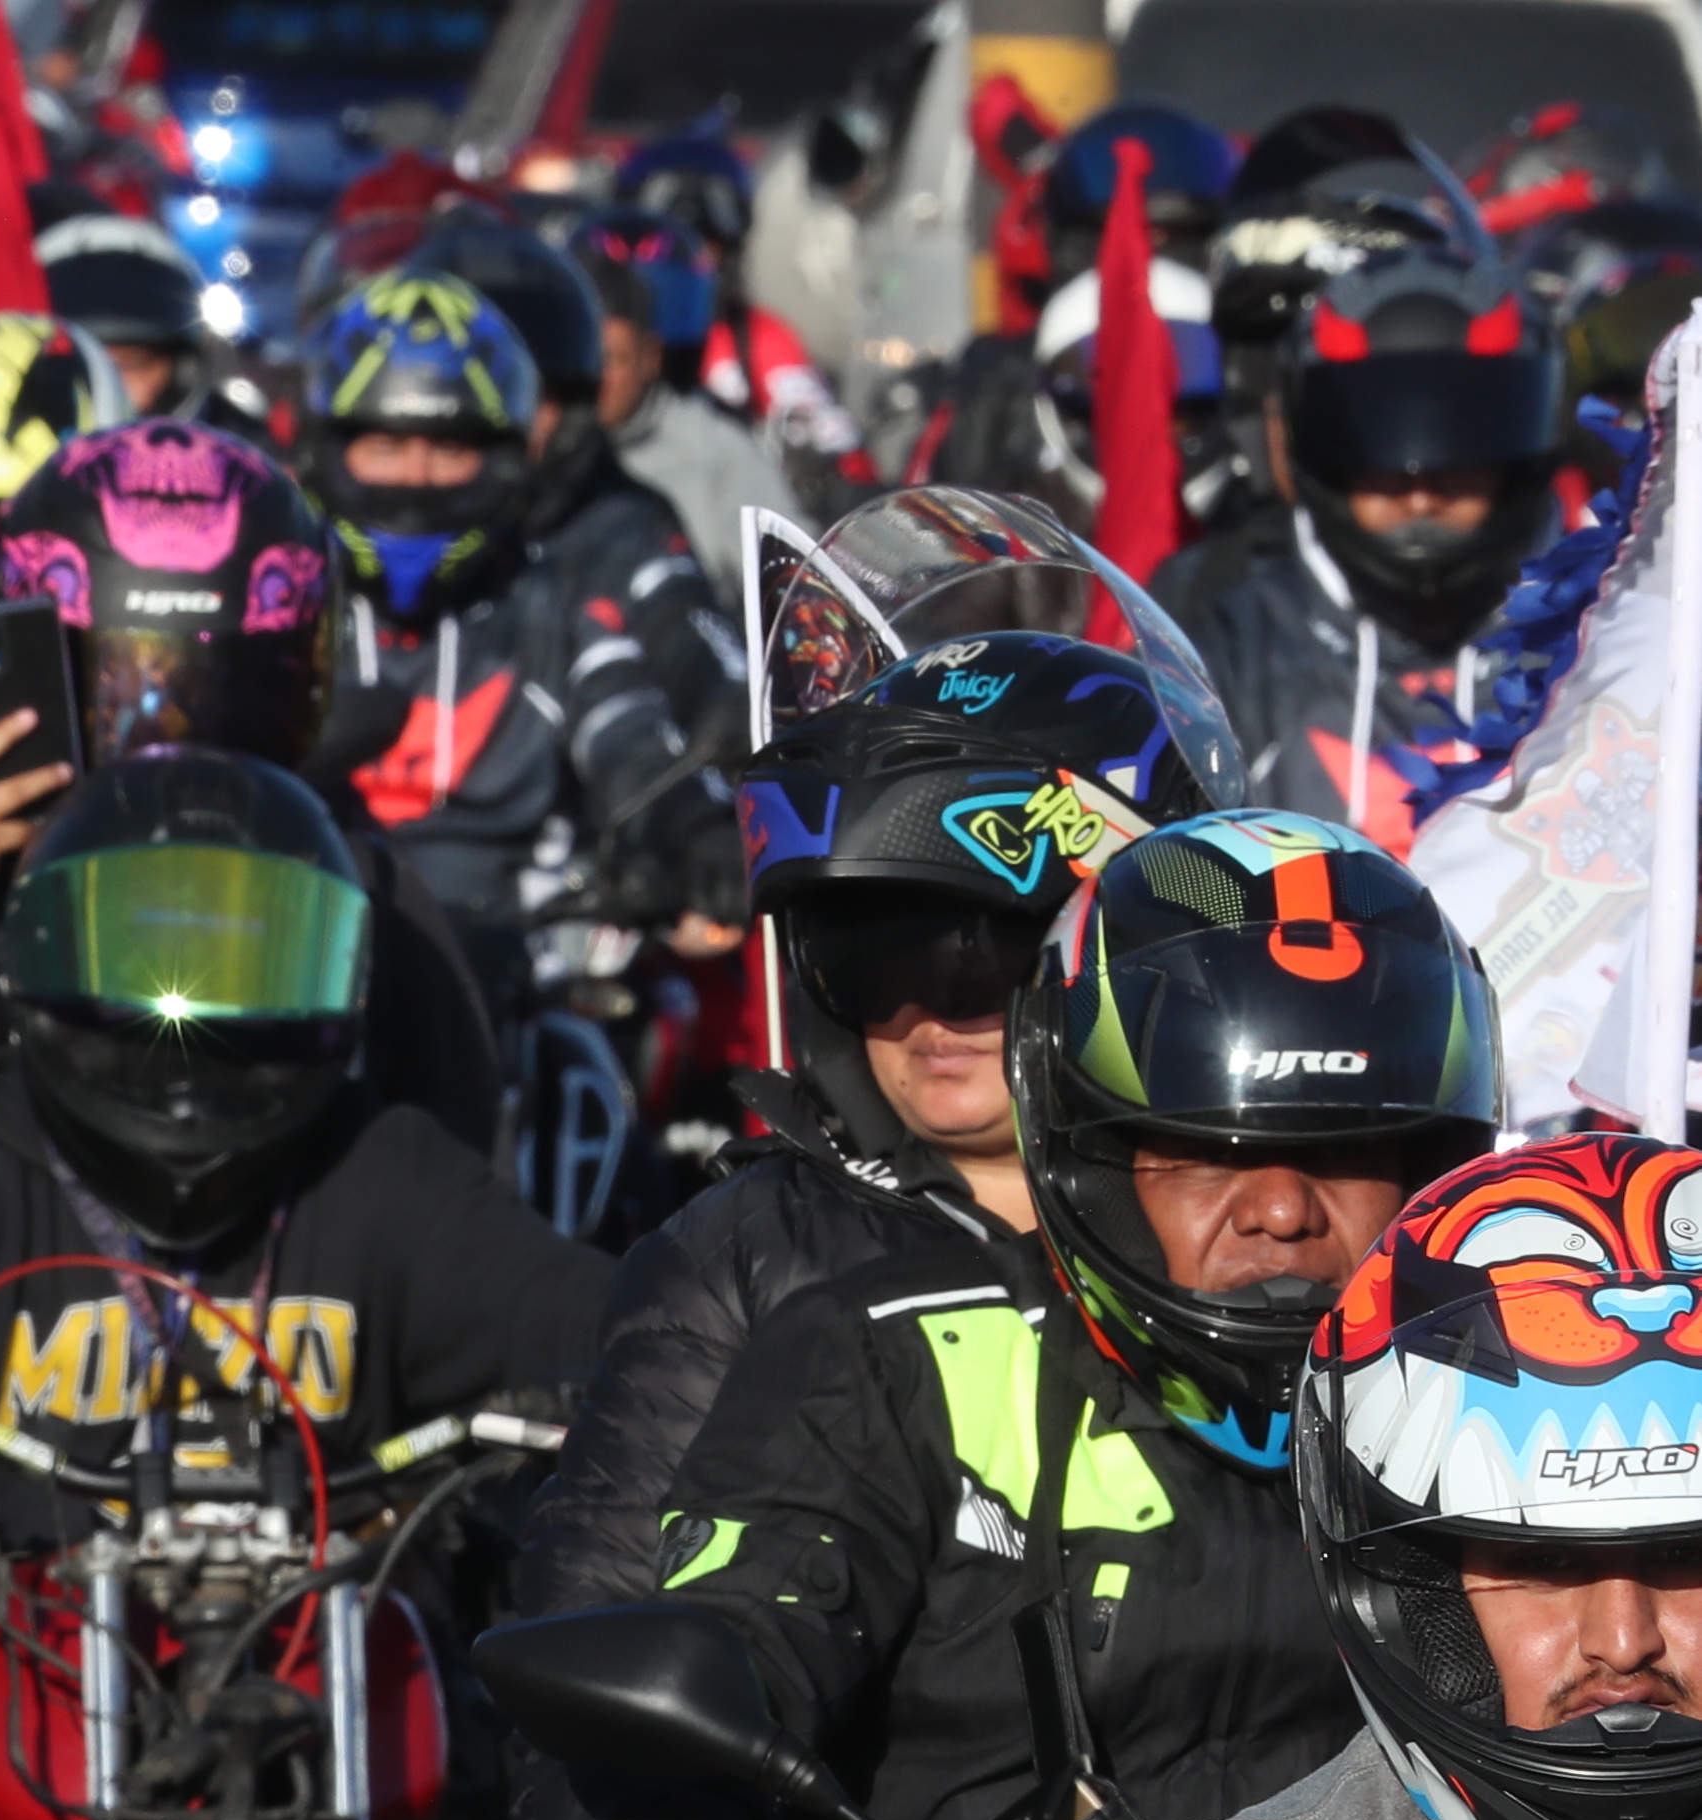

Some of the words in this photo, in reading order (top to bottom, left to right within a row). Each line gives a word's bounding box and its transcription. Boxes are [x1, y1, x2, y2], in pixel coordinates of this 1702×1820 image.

[913, 639, 990, 678] HRO
[1023, 783, 1105, 857] HRO
[1227, 1048, 1370, 1082] HRO
[1539, 1443, 1700, 1491] HRO
